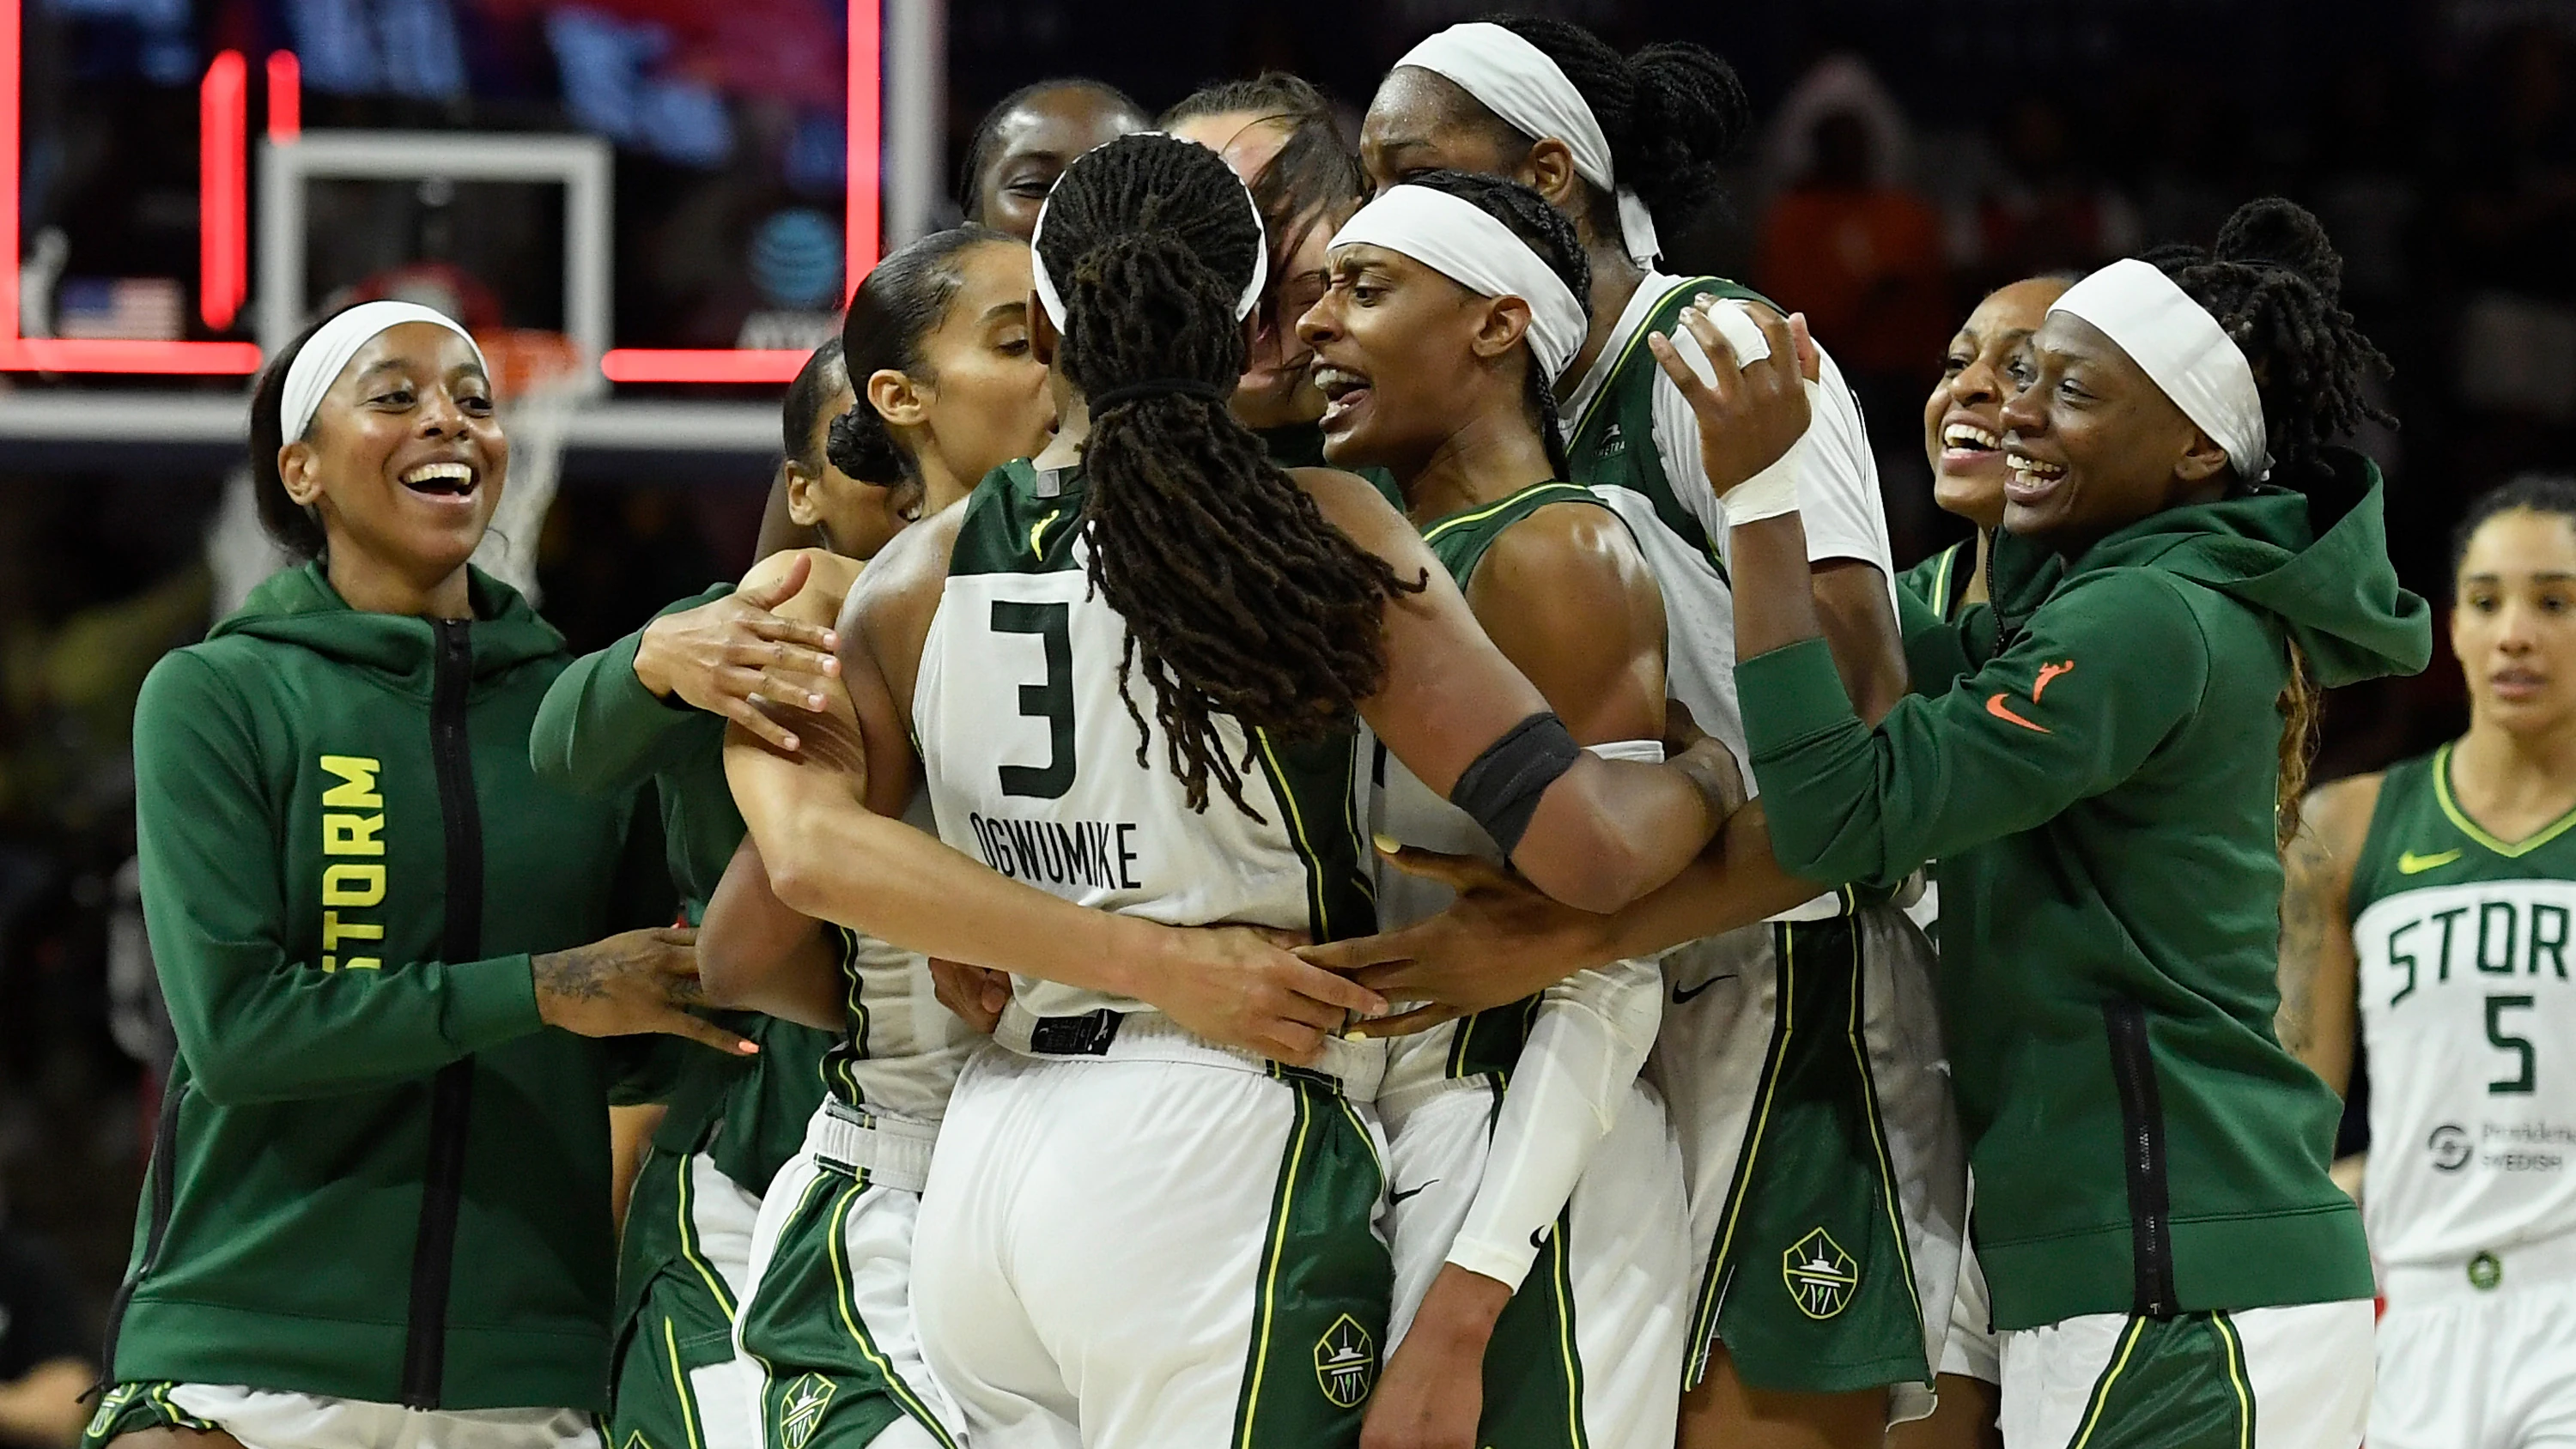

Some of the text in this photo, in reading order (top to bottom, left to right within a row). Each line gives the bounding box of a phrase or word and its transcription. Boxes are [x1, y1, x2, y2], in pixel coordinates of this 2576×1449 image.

[991, 600, 1076, 799] 3
[969, 812, 1142, 889] OGWUMIKE
[2390, 901, 2570, 1007] STOR
[2486, 996, 2535, 1093] 5
